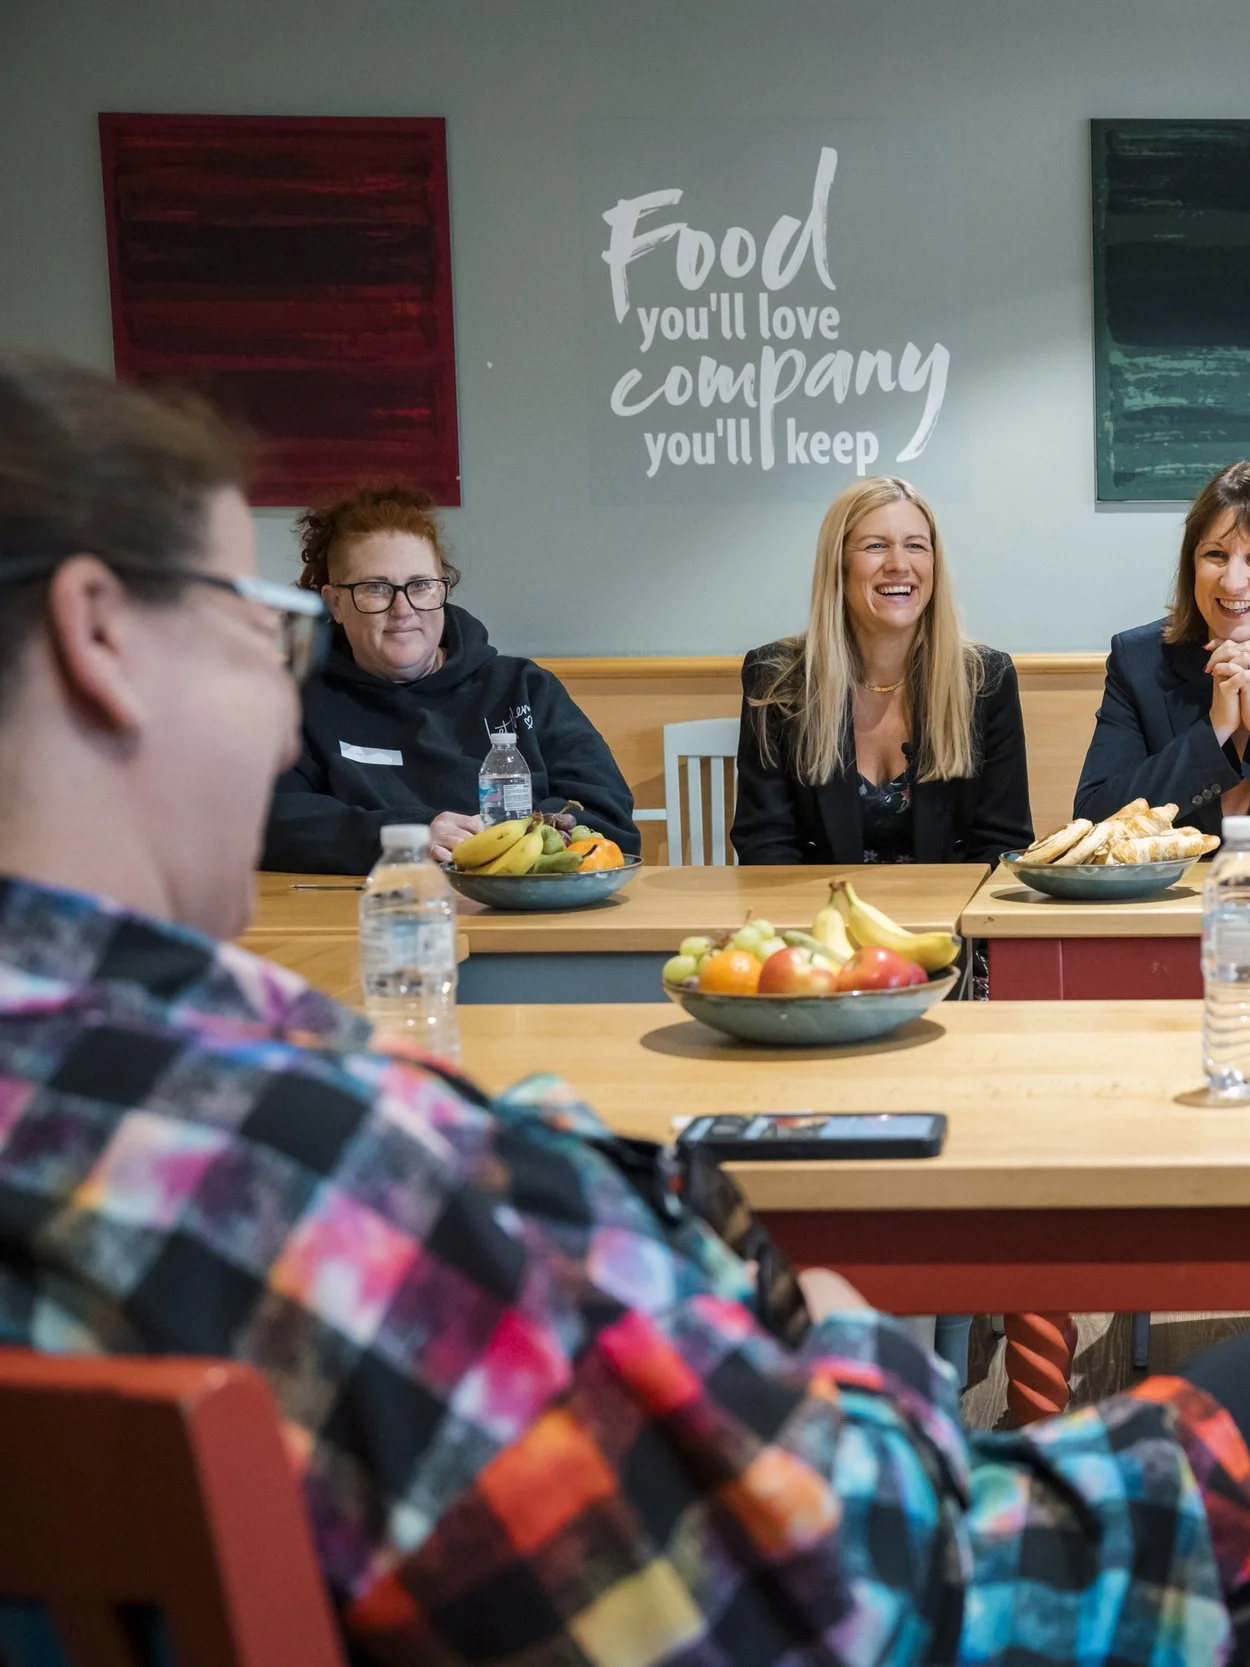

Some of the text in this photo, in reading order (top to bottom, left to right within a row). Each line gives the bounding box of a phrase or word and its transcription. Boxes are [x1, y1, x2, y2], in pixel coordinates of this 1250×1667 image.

[601, 145, 839, 324] Food
[637, 292, 841, 354] you'll love
[610, 341, 951, 471] company
[643, 417, 880, 479] you'll keep
